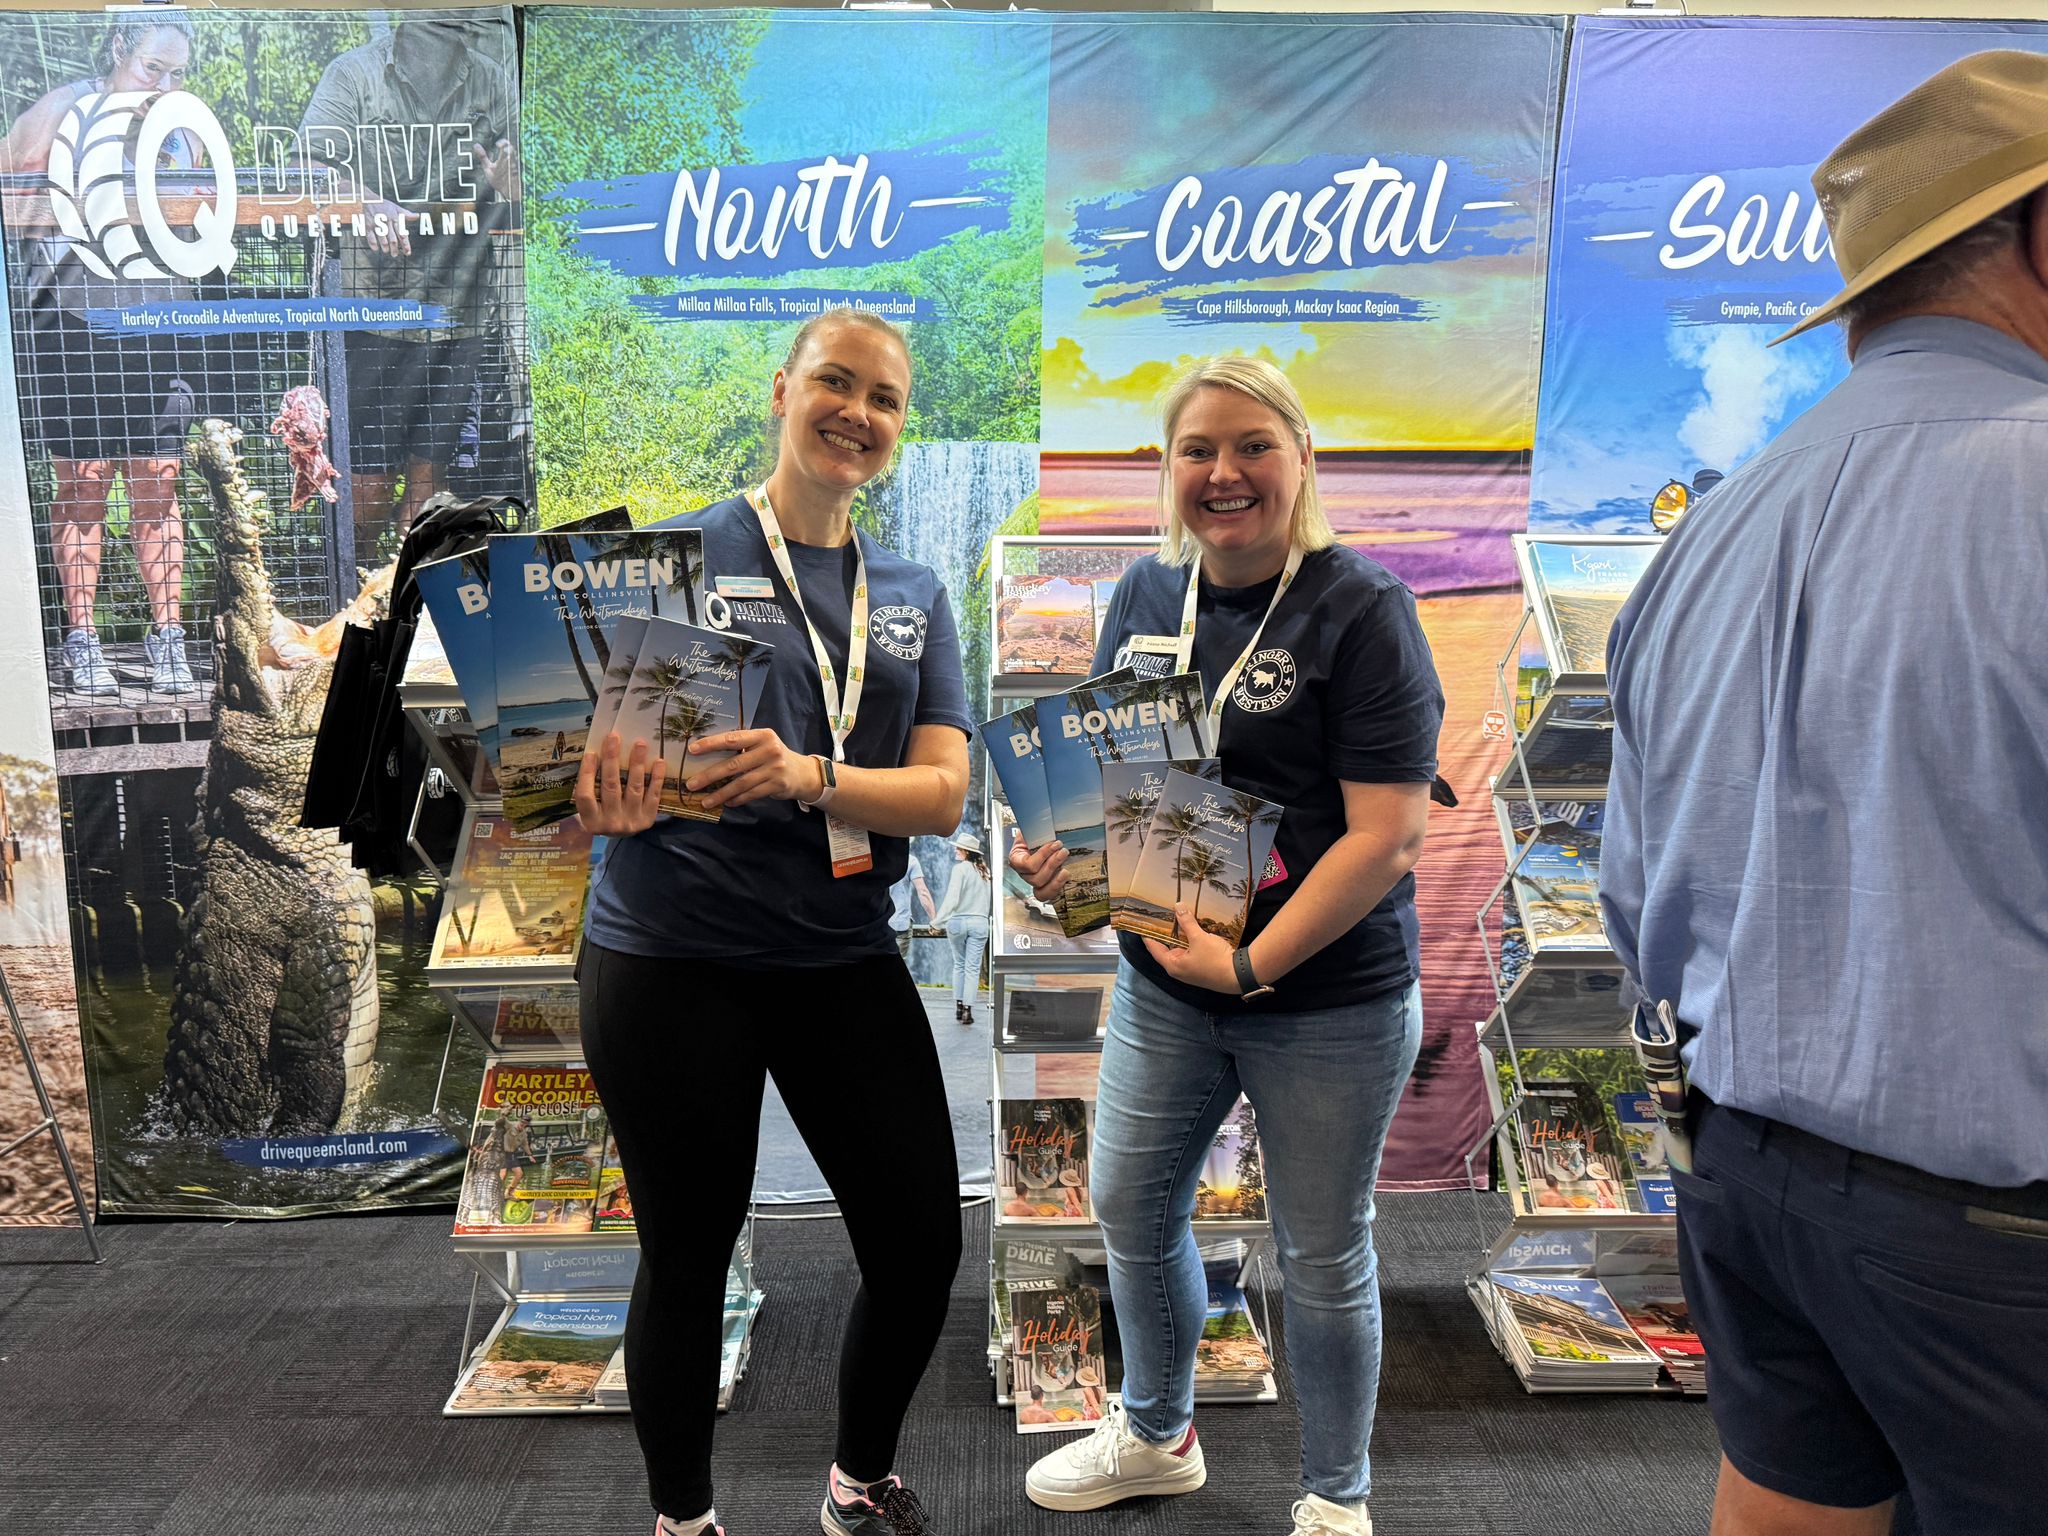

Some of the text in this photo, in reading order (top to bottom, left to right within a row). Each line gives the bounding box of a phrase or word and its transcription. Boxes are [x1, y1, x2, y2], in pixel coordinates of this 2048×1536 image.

[253, 123, 477, 205] DRIVE
[663, 153, 904, 267] North
[1154, 157, 1458, 272] Coastal
[260, 211, 479, 241] QUEENSLAND
[172, 310, 220, 326] Crocodile
[223, 308, 284, 326] Adventures,
[285, 307, 327, 327] Tropical
[330, 306, 359, 323] North
[362, 305, 423, 322] Queensland
[678, 296, 916, 316] Millaa Millaa Falls, Tropical North Queensland
[1196, 299, 1400, 318] Cape Hillsborough, Mackay Isaac Region
[1721, 301, 1763, 319] Gympie,
[1766, 301, 1797, 317] Pacific
[523, 557, 674, 593] BOWEN
[543, 589, 659, 601] AND COLLINSVILLE
[553, 601, 648, 622] The Whitsundays
[733, 600, 786, 620] DRIVE
[872, 607, 926, 626] RINGERS
[690, 640, 712, 658] The
[668, 652, 738, 682] Whitsundays
[1131, 652, 1172, 674] DRIVE
[1235, 686, 1288, 710] WESTERN
[1061, 698, 1180, 739] BOWEN
[1077, 725, 1168, 744] AND COLLINSVILLE
[1087, 737, 1161, 759] The Whitsundays
[532, 781, 564, 791] TO STAY
[1141, 772, 1163, 786] The
[1202, 792, 1221, 809] The
[1183, 801, 1246, 833] Whitsundays
[514, 851, 540, 859] BROWN
[541, 851, 561, 859] BAND
[515, 1103, 533, 1118] UP
[1009, 1124, 1078, 1159] Holiday
[1532, 1119, 1598, 1153] Holiday
[1561, 1141, 1586, 1150] Guide
[260, 1136, 408, 1163] drivequeensland.com
[1039, 1147, 1063, 1155] Guide
[1005, 1280, 1057, 1290] DRIVE
[1513, 1279, 1581, 1293] IPSWICH
[532, 1320, 609, 1330] Queensland
[534, 1311, 618, 1322] Tropical North
[1022, 1317, 1093, 1355] Holiday
[1052, 1343, 1078, 1353] Guide
